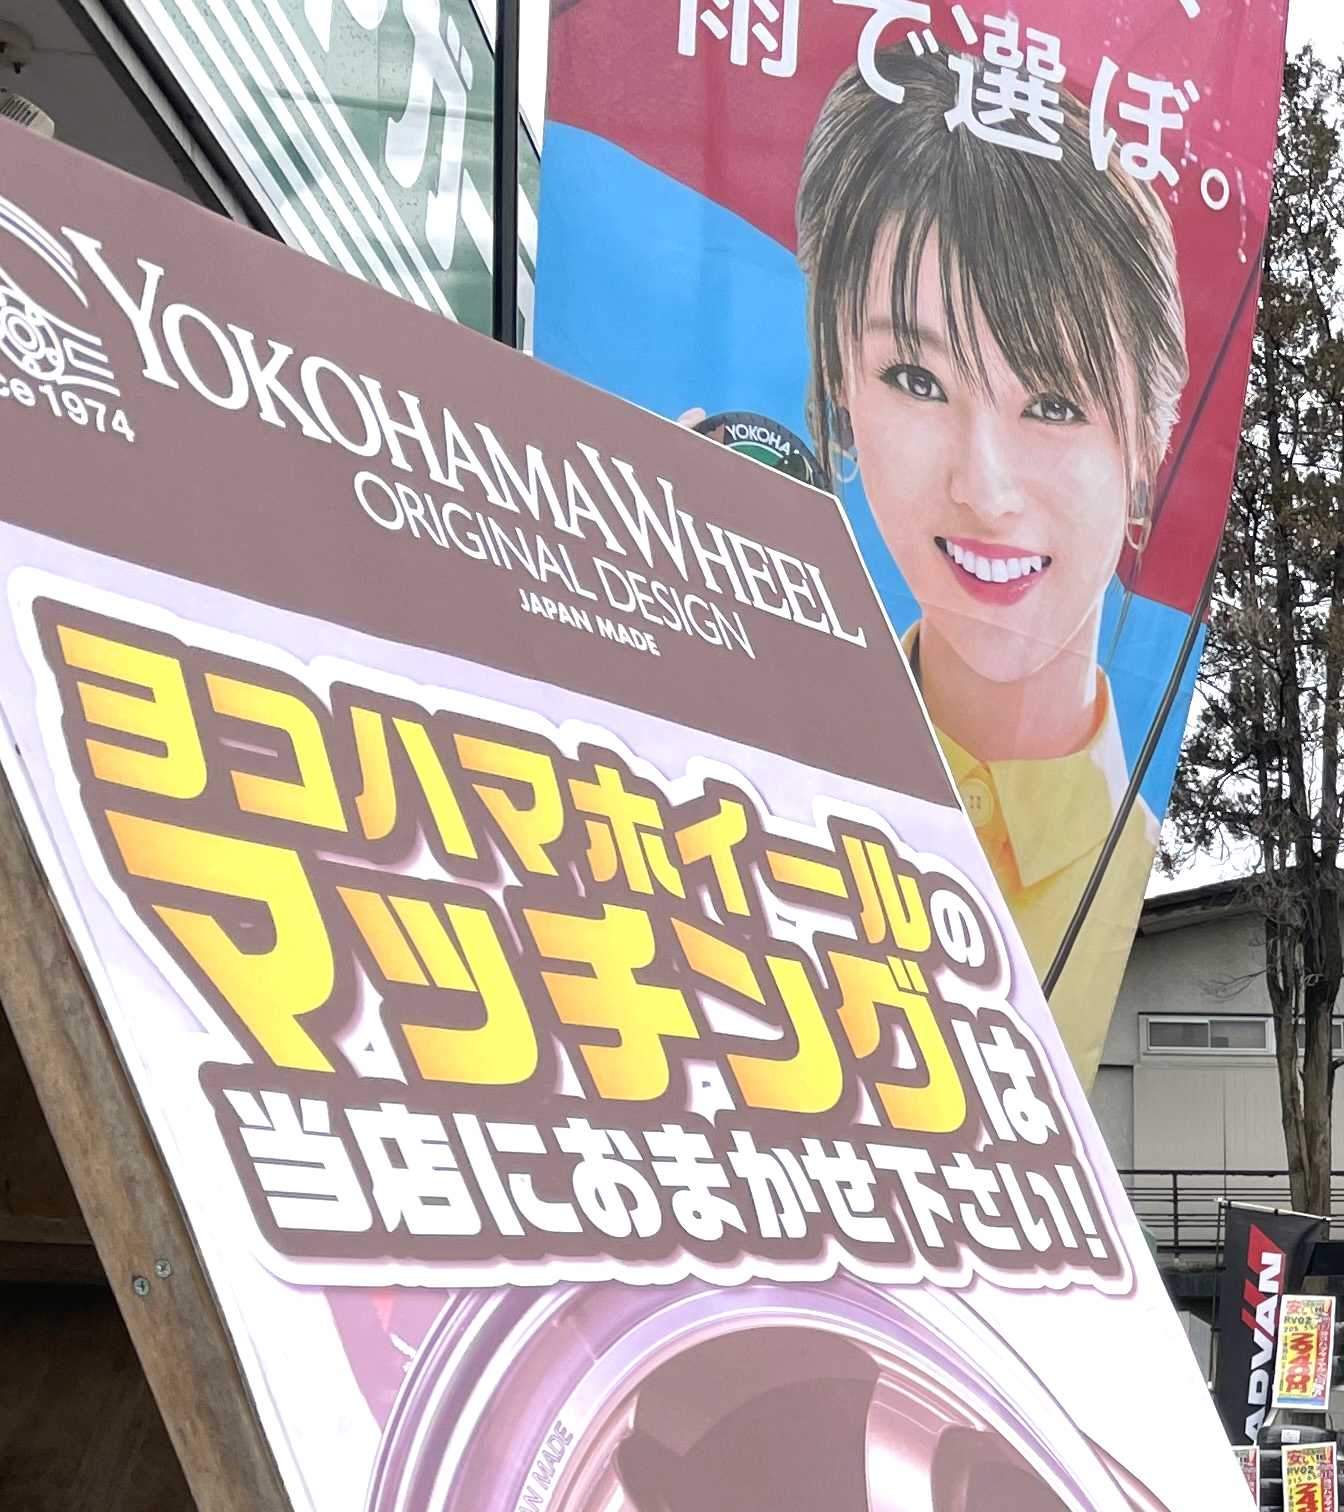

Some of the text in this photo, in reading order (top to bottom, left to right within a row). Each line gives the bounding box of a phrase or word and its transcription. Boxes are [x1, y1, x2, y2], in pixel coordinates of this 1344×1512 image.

[38, 382, 135, 443] 1974
[725, 423, 799, 456] YOKOHA
[353, 470, 757, 660] ORIGINAL DESIGN
[519, 588, 662, 658] JAPAN MADE
[56, 622, 985, 968] ヨコハマホイールの
[1244, 1251, 1283, 1445] ADVAN
[537, 1420, 576, 1491] MADE
